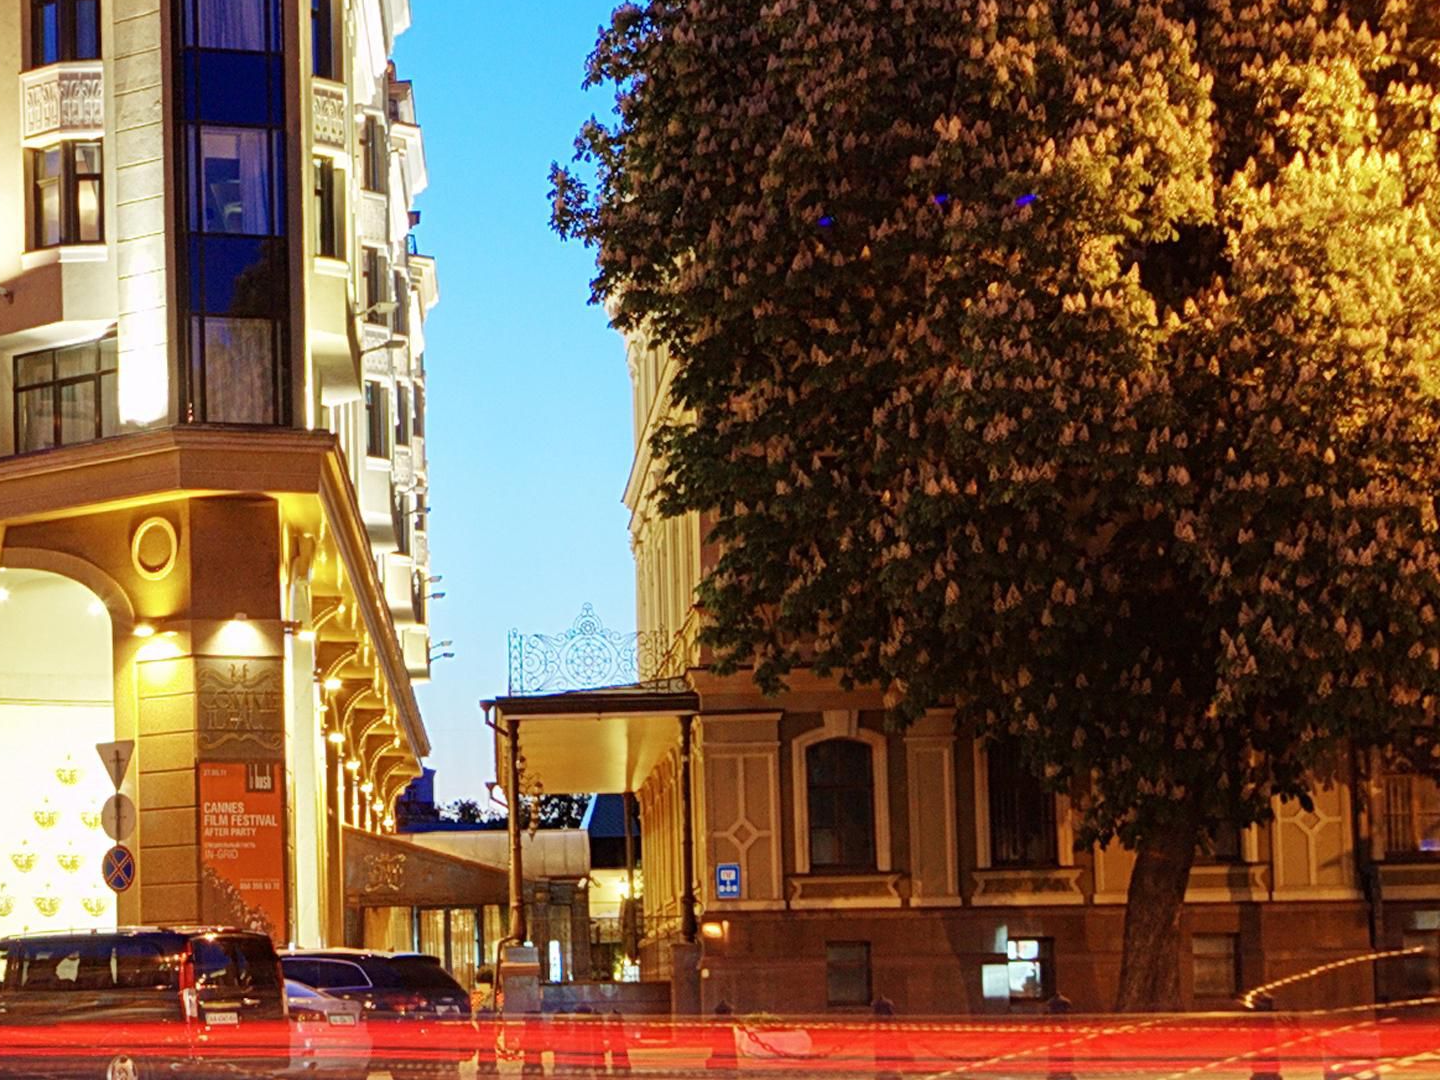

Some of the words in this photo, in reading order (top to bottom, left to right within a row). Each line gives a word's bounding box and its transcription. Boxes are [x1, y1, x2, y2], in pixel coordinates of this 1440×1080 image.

[203, 801, 245, 814] CANNES
[203, 814, 228, 826] FILM
[231, 814, 278, 827] FESTIVAL
[204, 827, 229, 837] AFTER
[231, 826, 257, 837] PARTY
